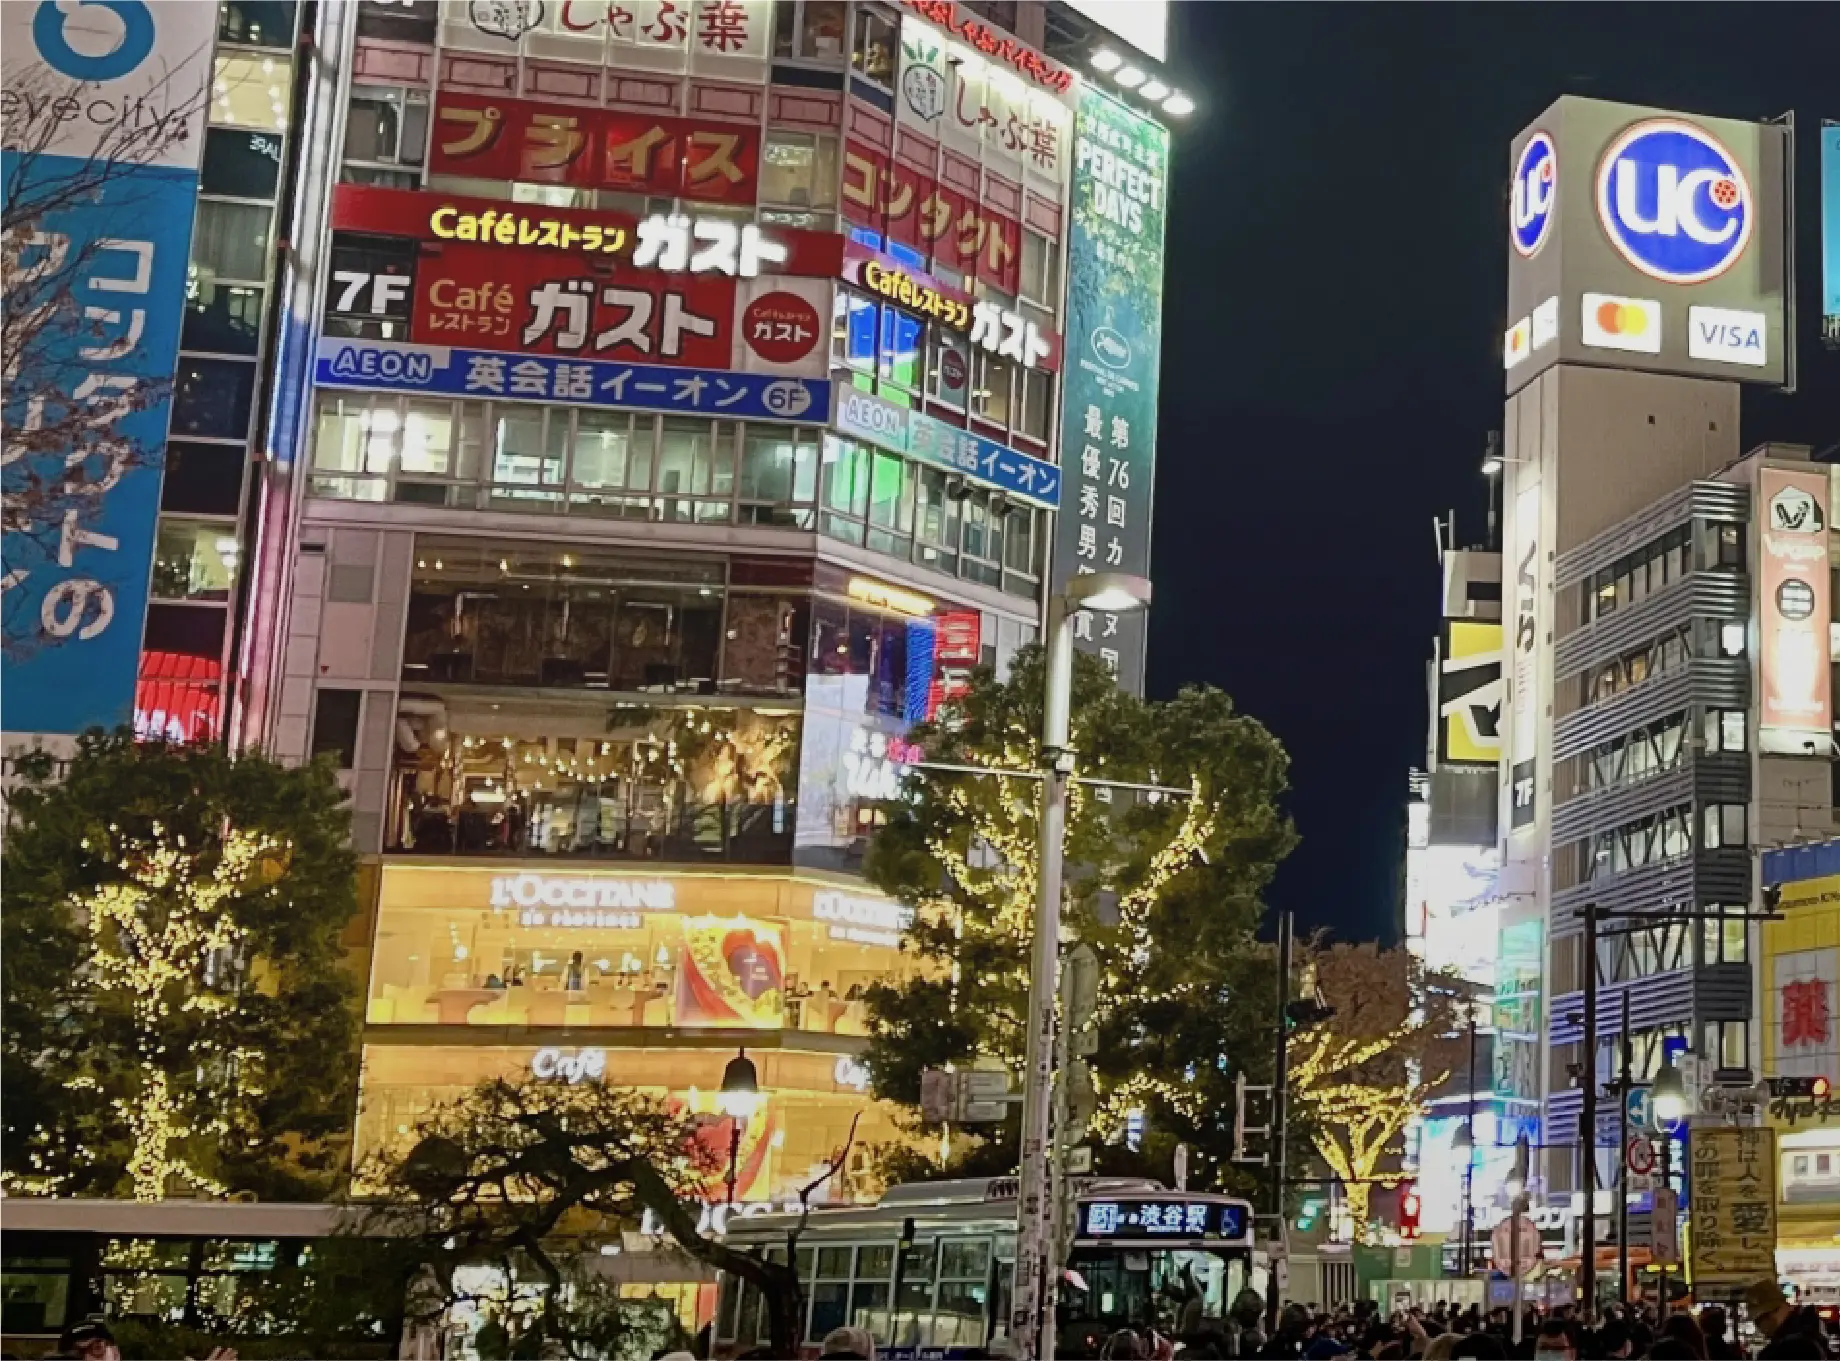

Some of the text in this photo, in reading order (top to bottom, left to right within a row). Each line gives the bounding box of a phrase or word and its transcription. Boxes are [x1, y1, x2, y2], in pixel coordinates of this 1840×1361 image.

[440, 106, 748, 185] プライス
[1076, 136, 1164, 211] PERFECT
[842, 148, 1016, 272] コンタクト
[1094, 170, 1143, 236] DAYS
[430, 206, 790, 278] Café レストラン ガスト
[332, 271, 411, 313] 7F
[427, 279, 716, 357] Café ガスト
[864, 260, 1052, 367] Café レストラン ガスト
[428, 314, 511, 334] レストラン
[753, 321, 813, 343] ガスト
[1699, 322, 1762, 351] VISA
[333, 348, 431, 380] AEON
[465, 355, 748, 409] 英会話イーオン
[768, 387, 809, 413] 6F
[41, 238, 155, 642] コンタクトの
[531, 1046, 608, 1083] Café
[1139, 1203, 1208, 1233] 渋谷駅
